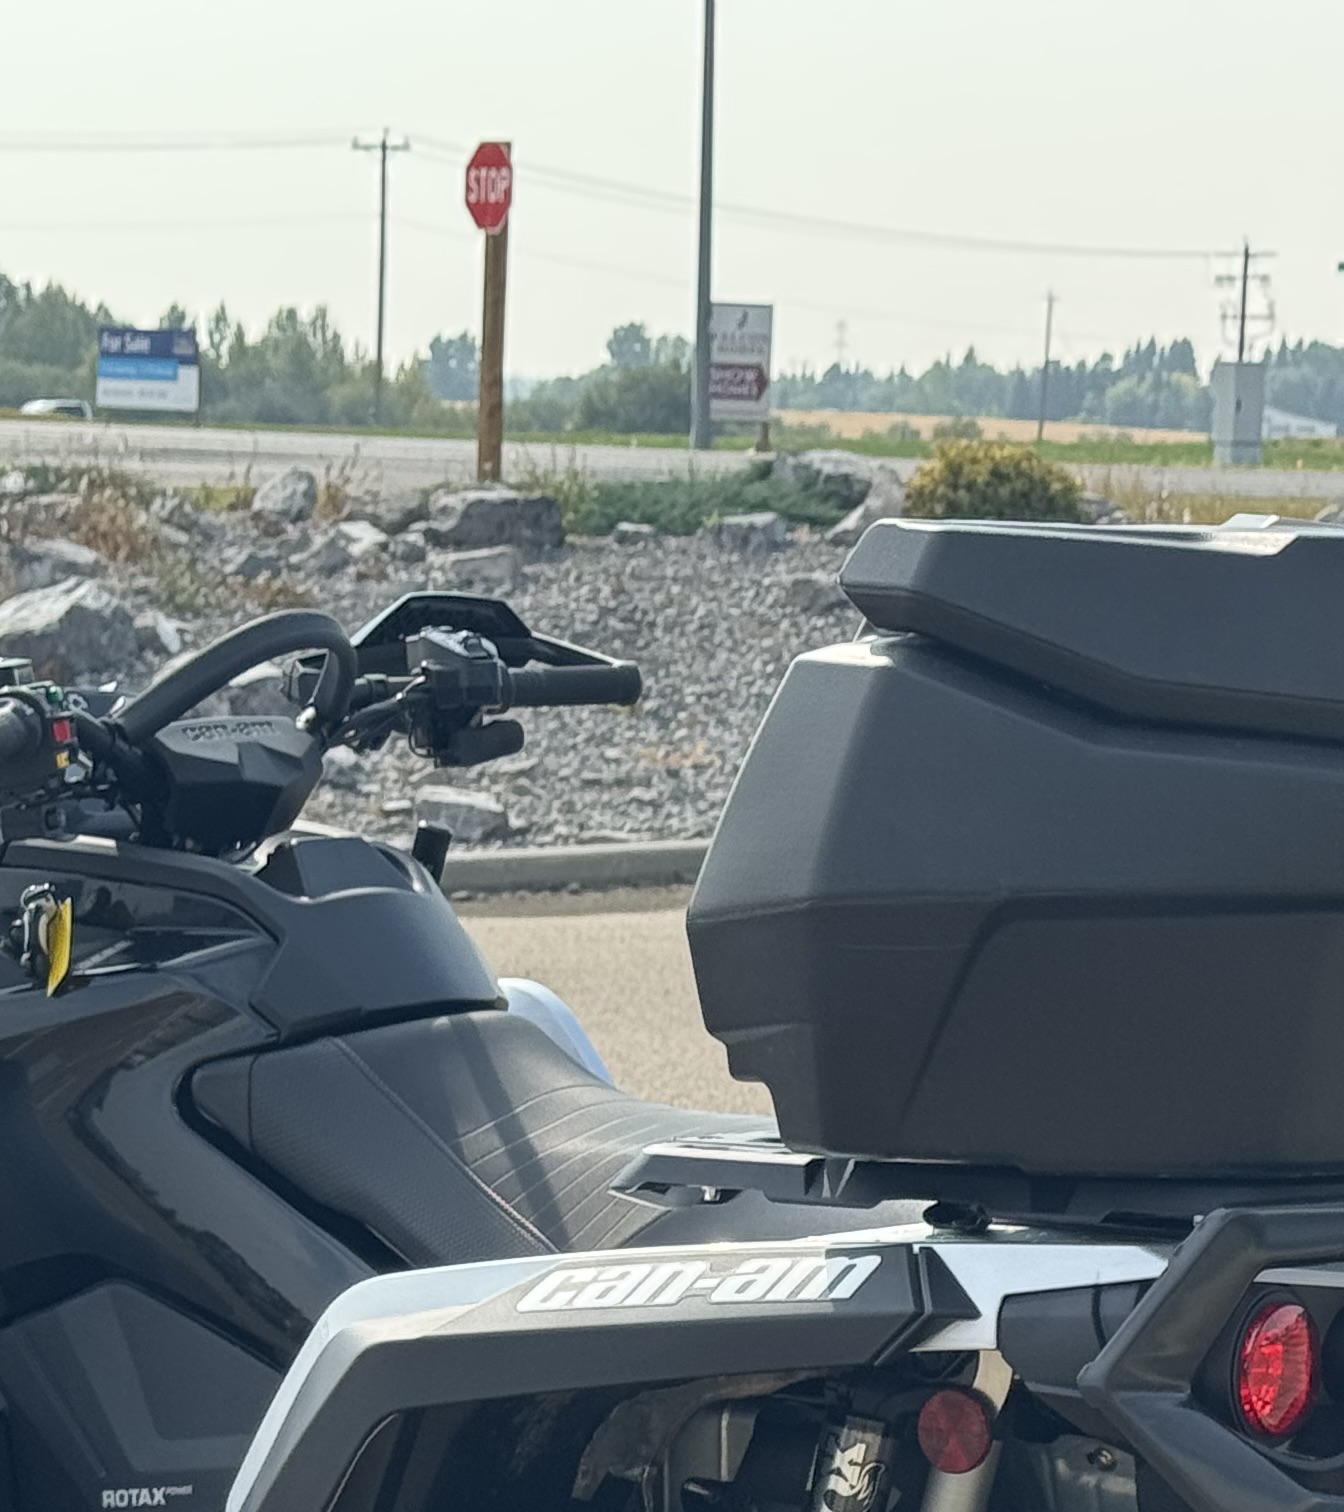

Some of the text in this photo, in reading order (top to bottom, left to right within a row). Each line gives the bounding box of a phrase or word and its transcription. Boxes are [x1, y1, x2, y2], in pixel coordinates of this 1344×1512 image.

[467, 166, 511, 204] STOP
[515, 1254, 883, 1313] can-am
[102, 1487, 166, 1509] ROTAX
